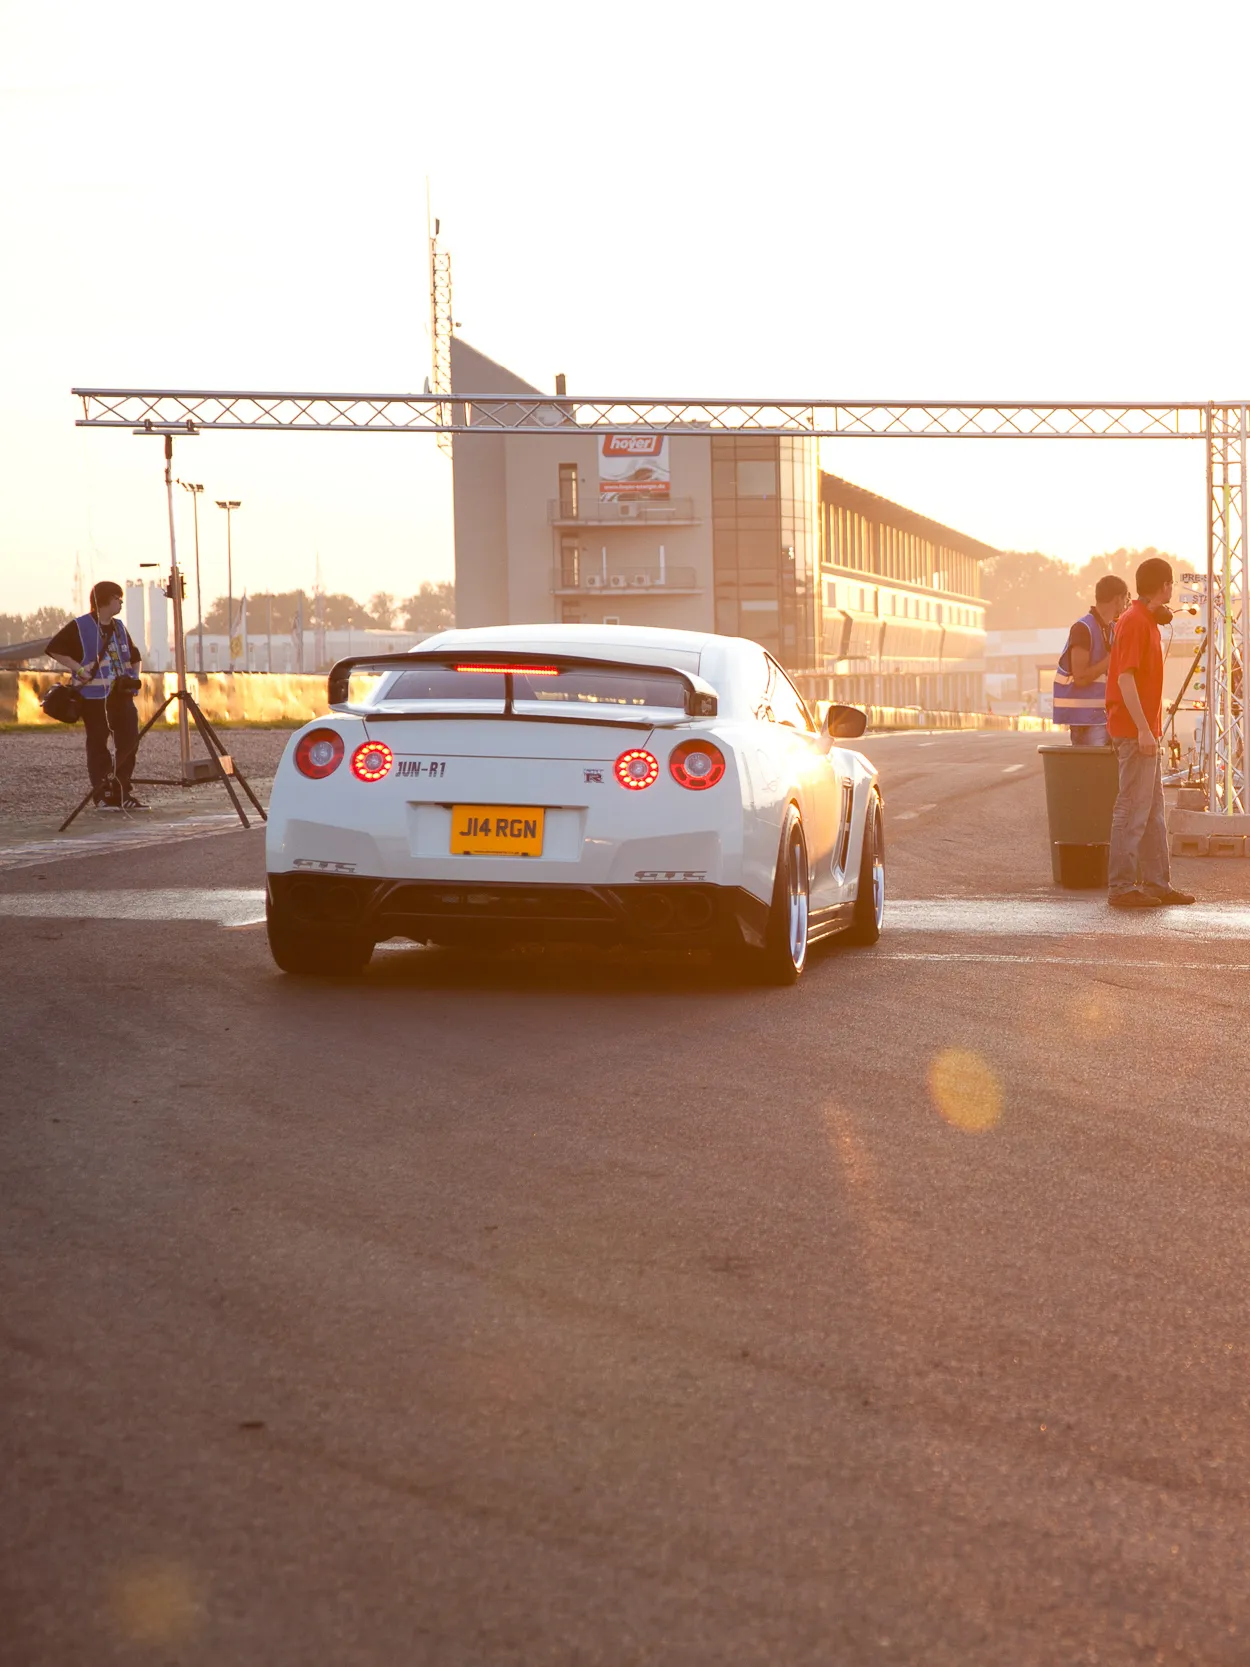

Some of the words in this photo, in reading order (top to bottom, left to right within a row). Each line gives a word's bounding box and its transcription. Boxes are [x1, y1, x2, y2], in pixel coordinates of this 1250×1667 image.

[610, 435, 652, 452] hoyer
[395, 762, 446, 778] JUN-R1
[459, 818, 491, 837] J14
[496, 818, 537, 839] RGN
